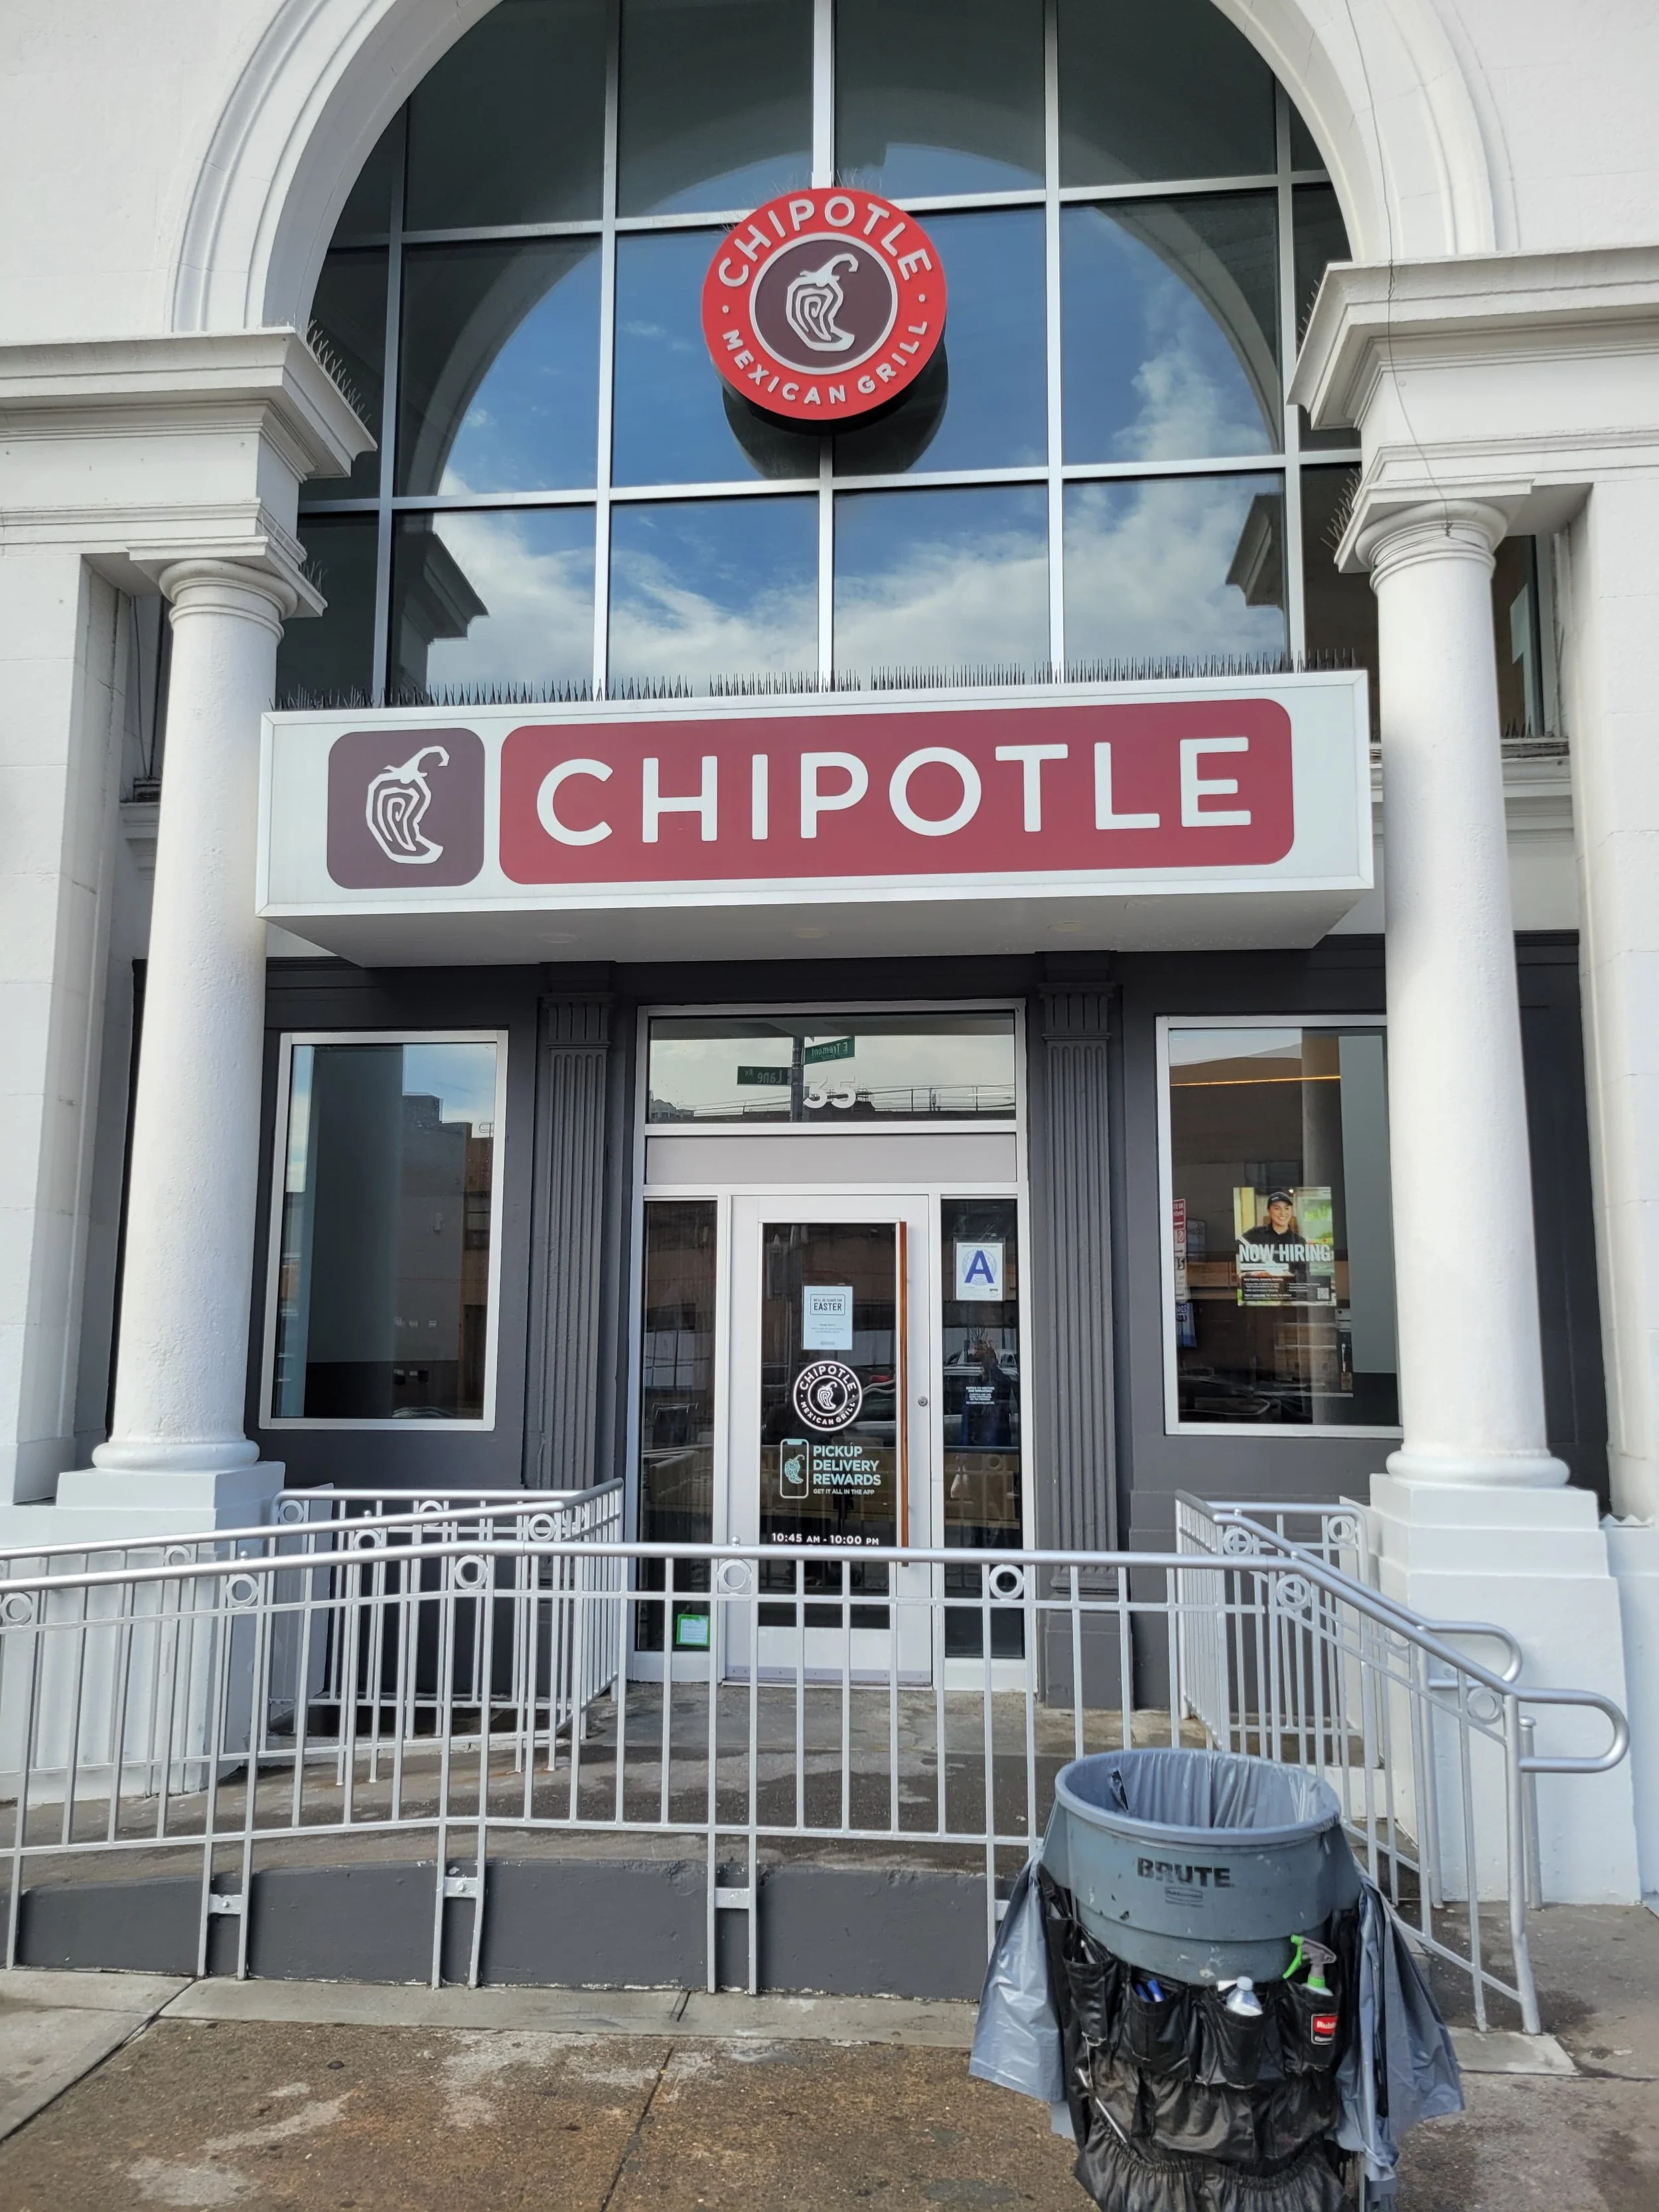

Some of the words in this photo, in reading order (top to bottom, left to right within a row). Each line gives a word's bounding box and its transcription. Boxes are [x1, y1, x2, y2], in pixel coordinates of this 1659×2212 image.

[719, 195, 932, 287] CHIPOTLE
[723, 329, 846, 405] MEXICAN
[857, 321, 928, 395] GRILL
[536, 737, 1252, 846] CHIPOTLE
[802, 1076, 857, 1109] 35
[1239, 1244, 1275, 1262] NOW
[1278, 1244, 1331, 1262] HIRING
[964, 1250, 995, 1284] A
[814, 1302, 842, 1311] EASTER
[800, 1365, 857, 1392] CHIPOTLE
[800, 1401, 835, 1426] MEXICAN
[835, 1402, 855, 1423] GRILL
[813, 1445, 863, 1457] PICKUP
[813, 1459, 880, 1472] DELIVERY
[813, 1473, 881, 1486] REWARDS
[772, 1532, 803, 1543] 10:45
[830, 1534, 862, 1545] 10:00
[1137, 1857, 1232, 1888] BRUTE
